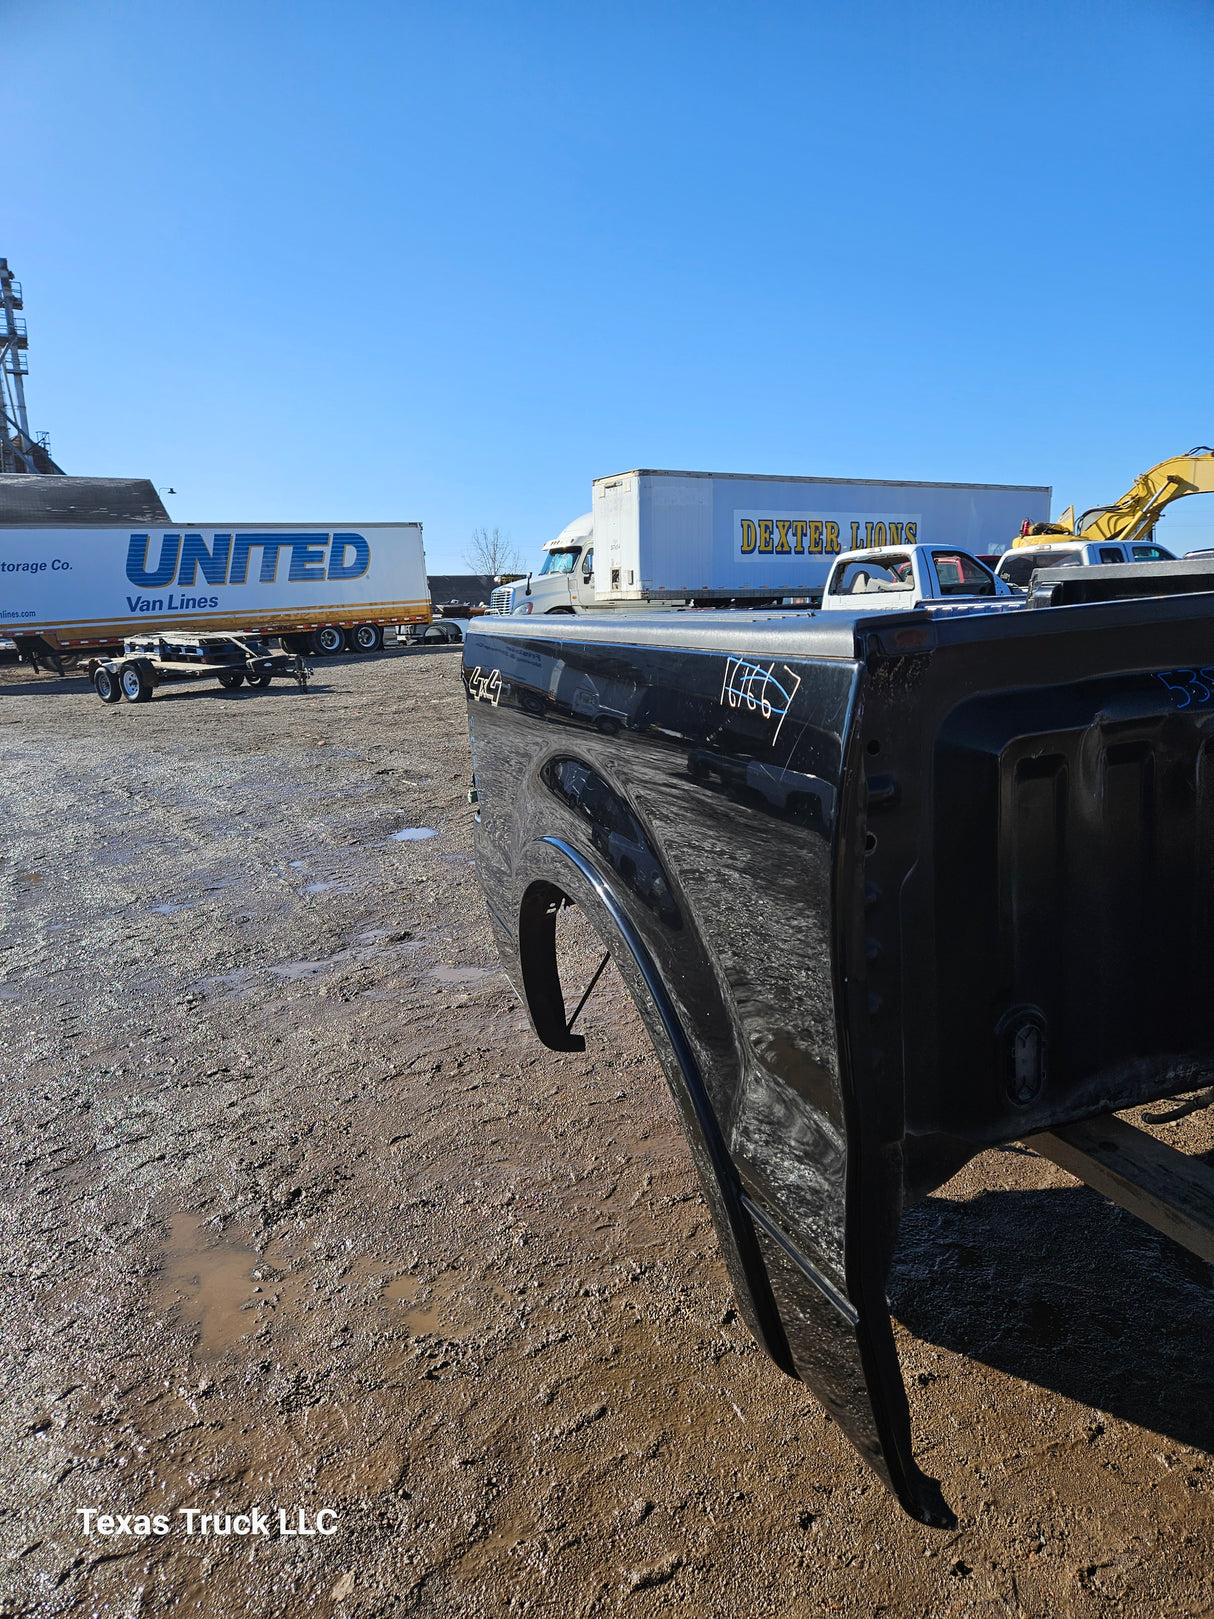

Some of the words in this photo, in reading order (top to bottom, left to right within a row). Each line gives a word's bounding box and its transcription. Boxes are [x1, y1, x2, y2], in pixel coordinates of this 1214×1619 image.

[740, 519, 841, 554] DEXTER
[850, 521, 917, 551] LIONS
[0, 561, 47, 574] torage
[51, 559, 73, 571] Co.
[126, 533, 371, 588] UNITED
[127, 595, 164, 613] Van
[167, 594, 219, 610] Lines
[469, 666, 502, 707] 4x4
